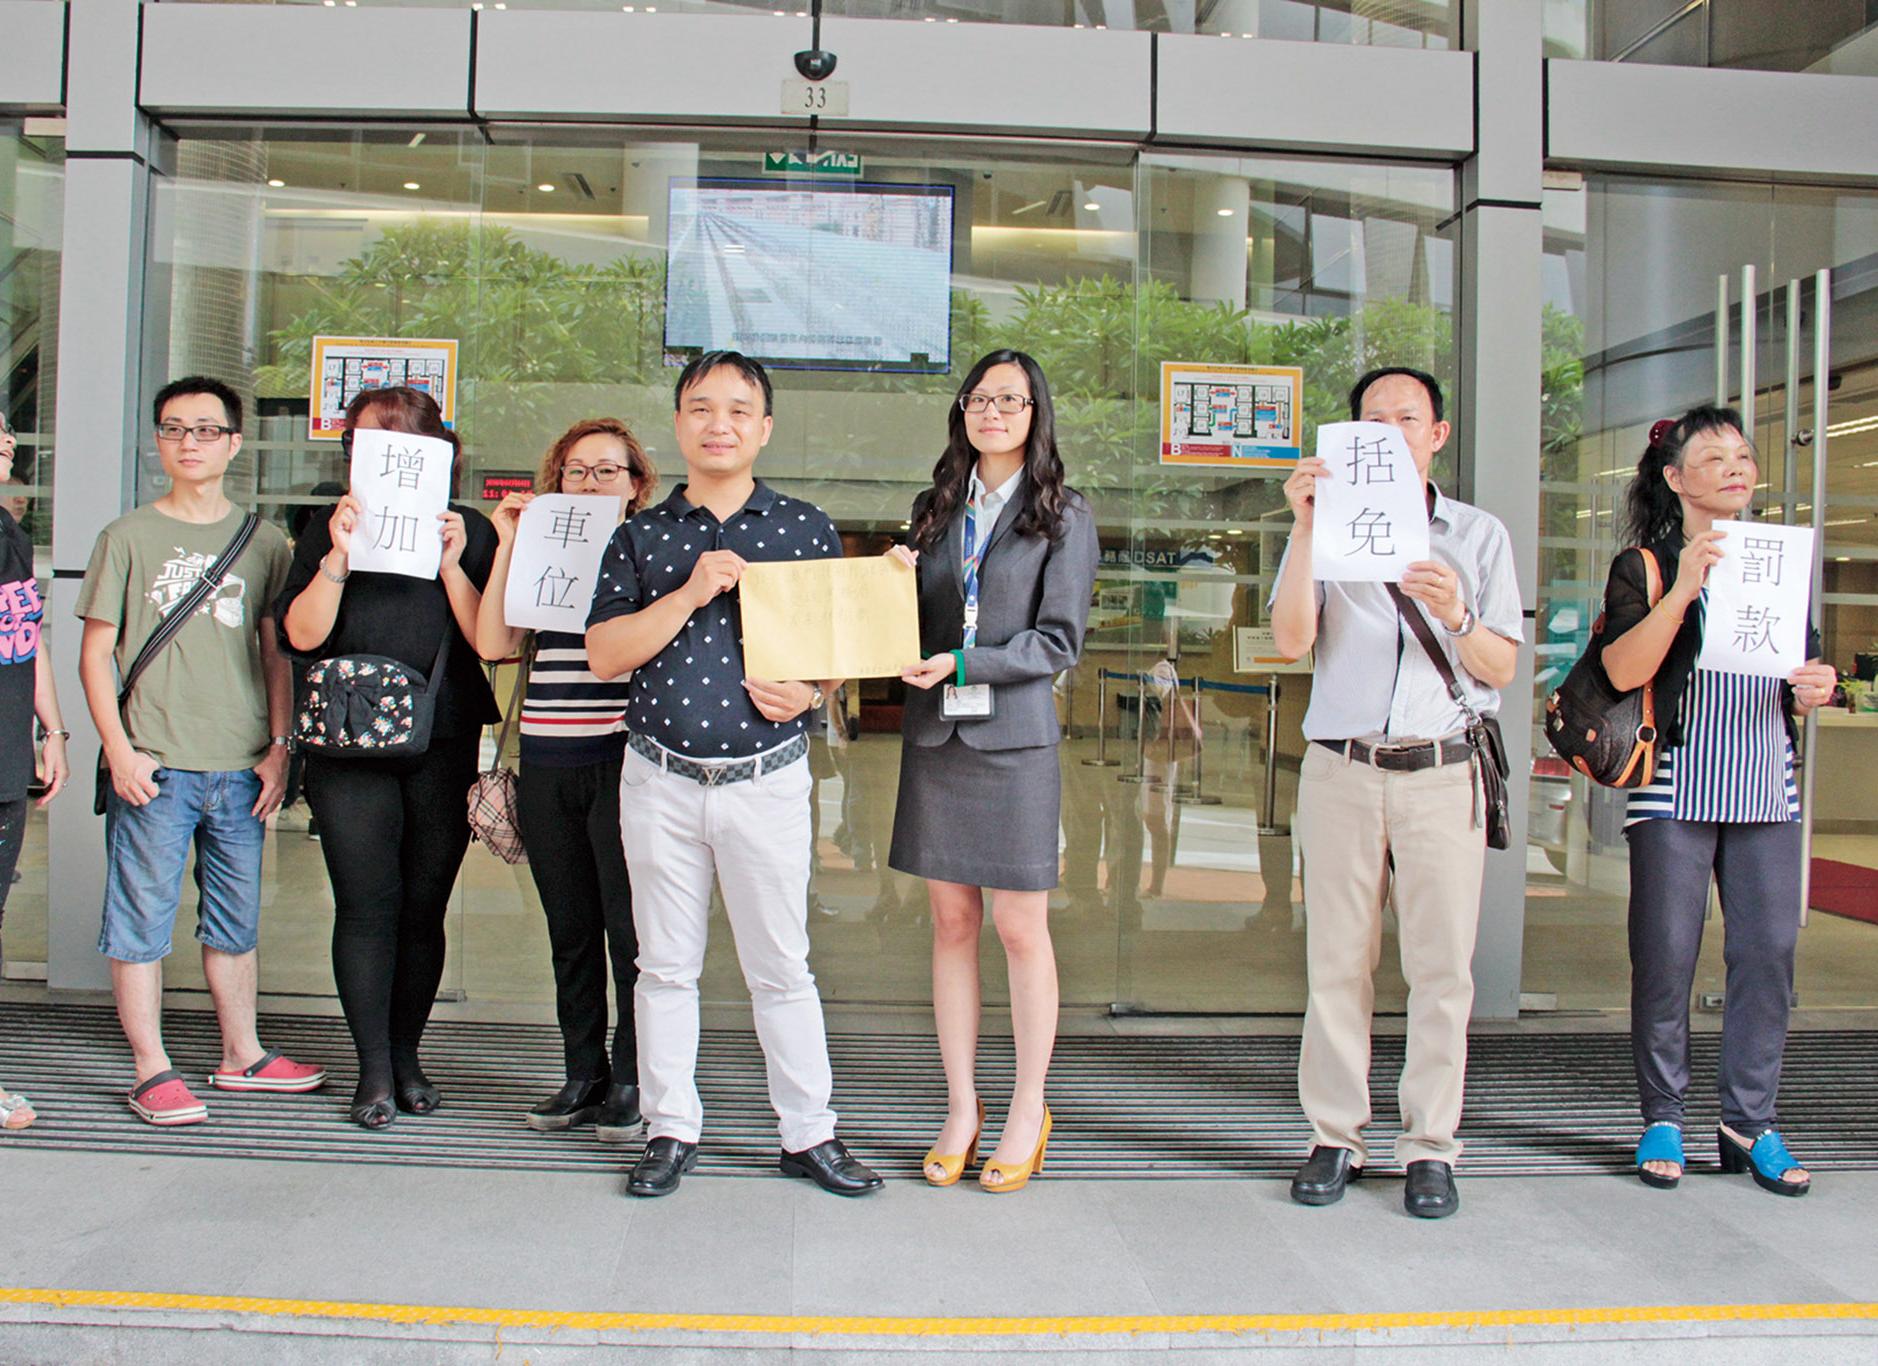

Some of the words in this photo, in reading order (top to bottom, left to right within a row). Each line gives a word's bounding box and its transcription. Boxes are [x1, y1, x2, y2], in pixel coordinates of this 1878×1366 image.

[804, 86, 827, 109] 33
[372, 443, 425, 553] 增加
[1343, 435, 1396, 557] 括免
[533, 505, 592, 609] 車位
[1731, 536, 1785, 655] 罰款
